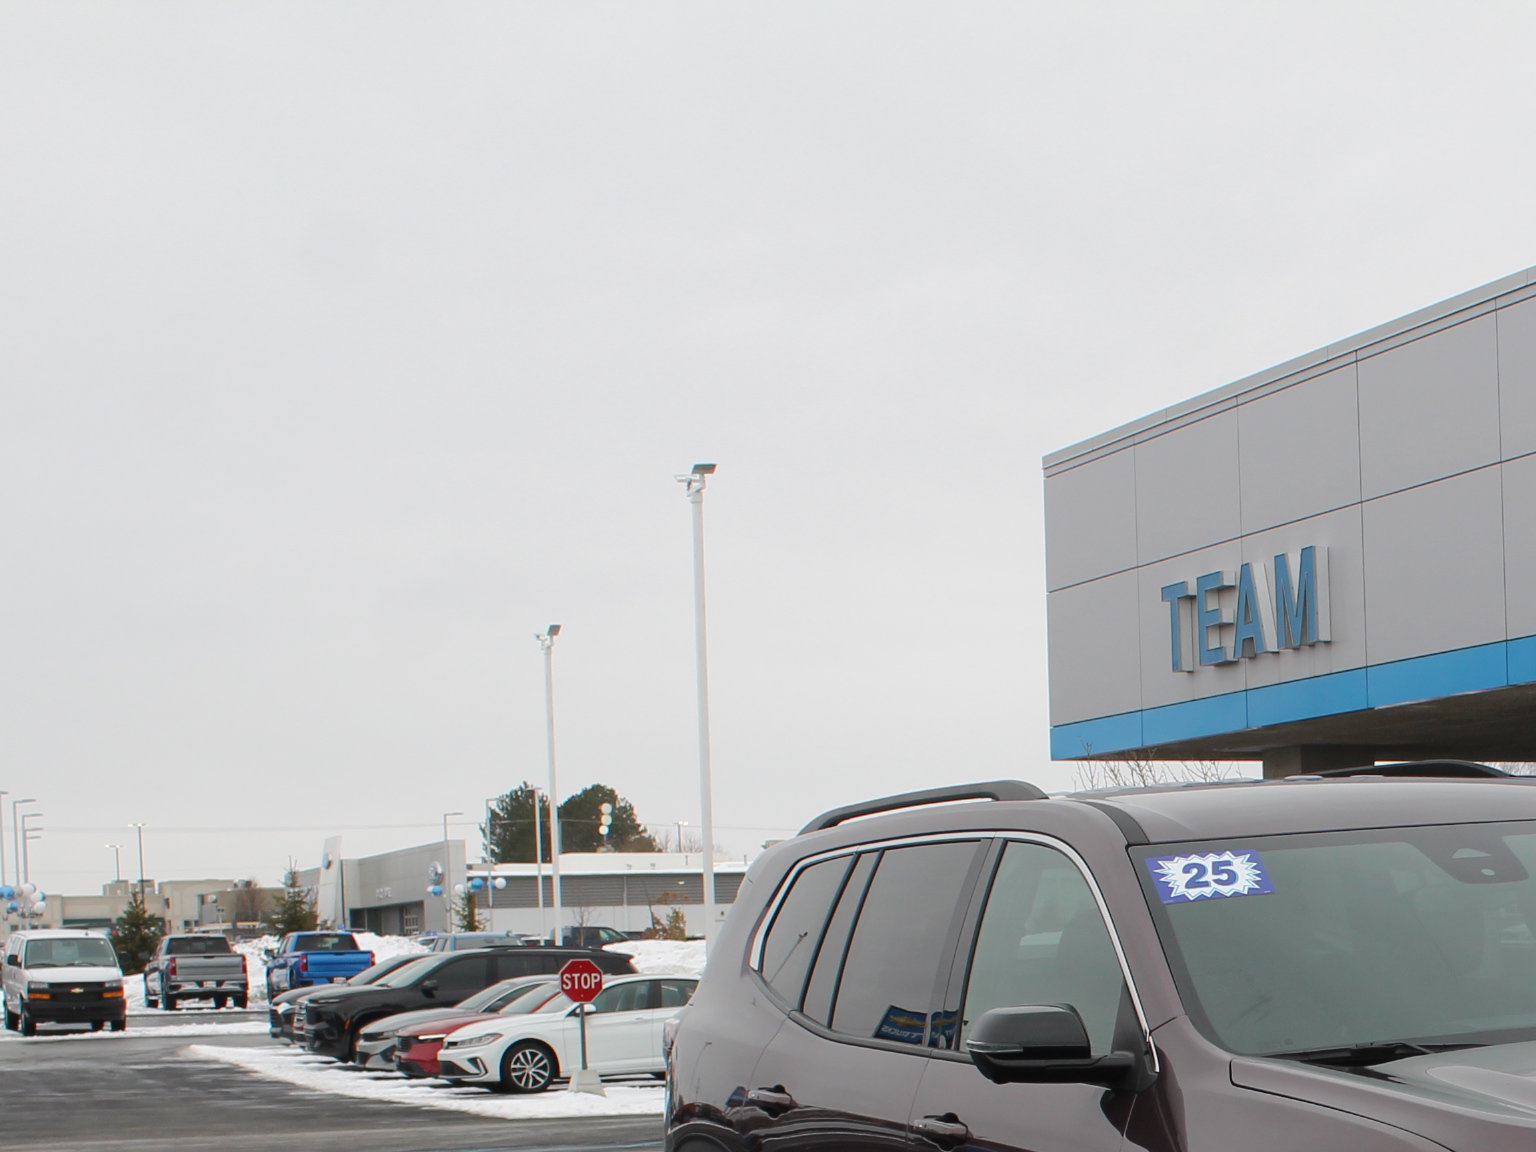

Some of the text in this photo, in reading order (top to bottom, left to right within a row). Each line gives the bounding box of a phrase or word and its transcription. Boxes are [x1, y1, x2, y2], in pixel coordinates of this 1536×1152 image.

[1160, 545, 1331, 673] TEAM
[1182, 860, 1239, 889] 25
[562, 973, 601, 990] STOP
